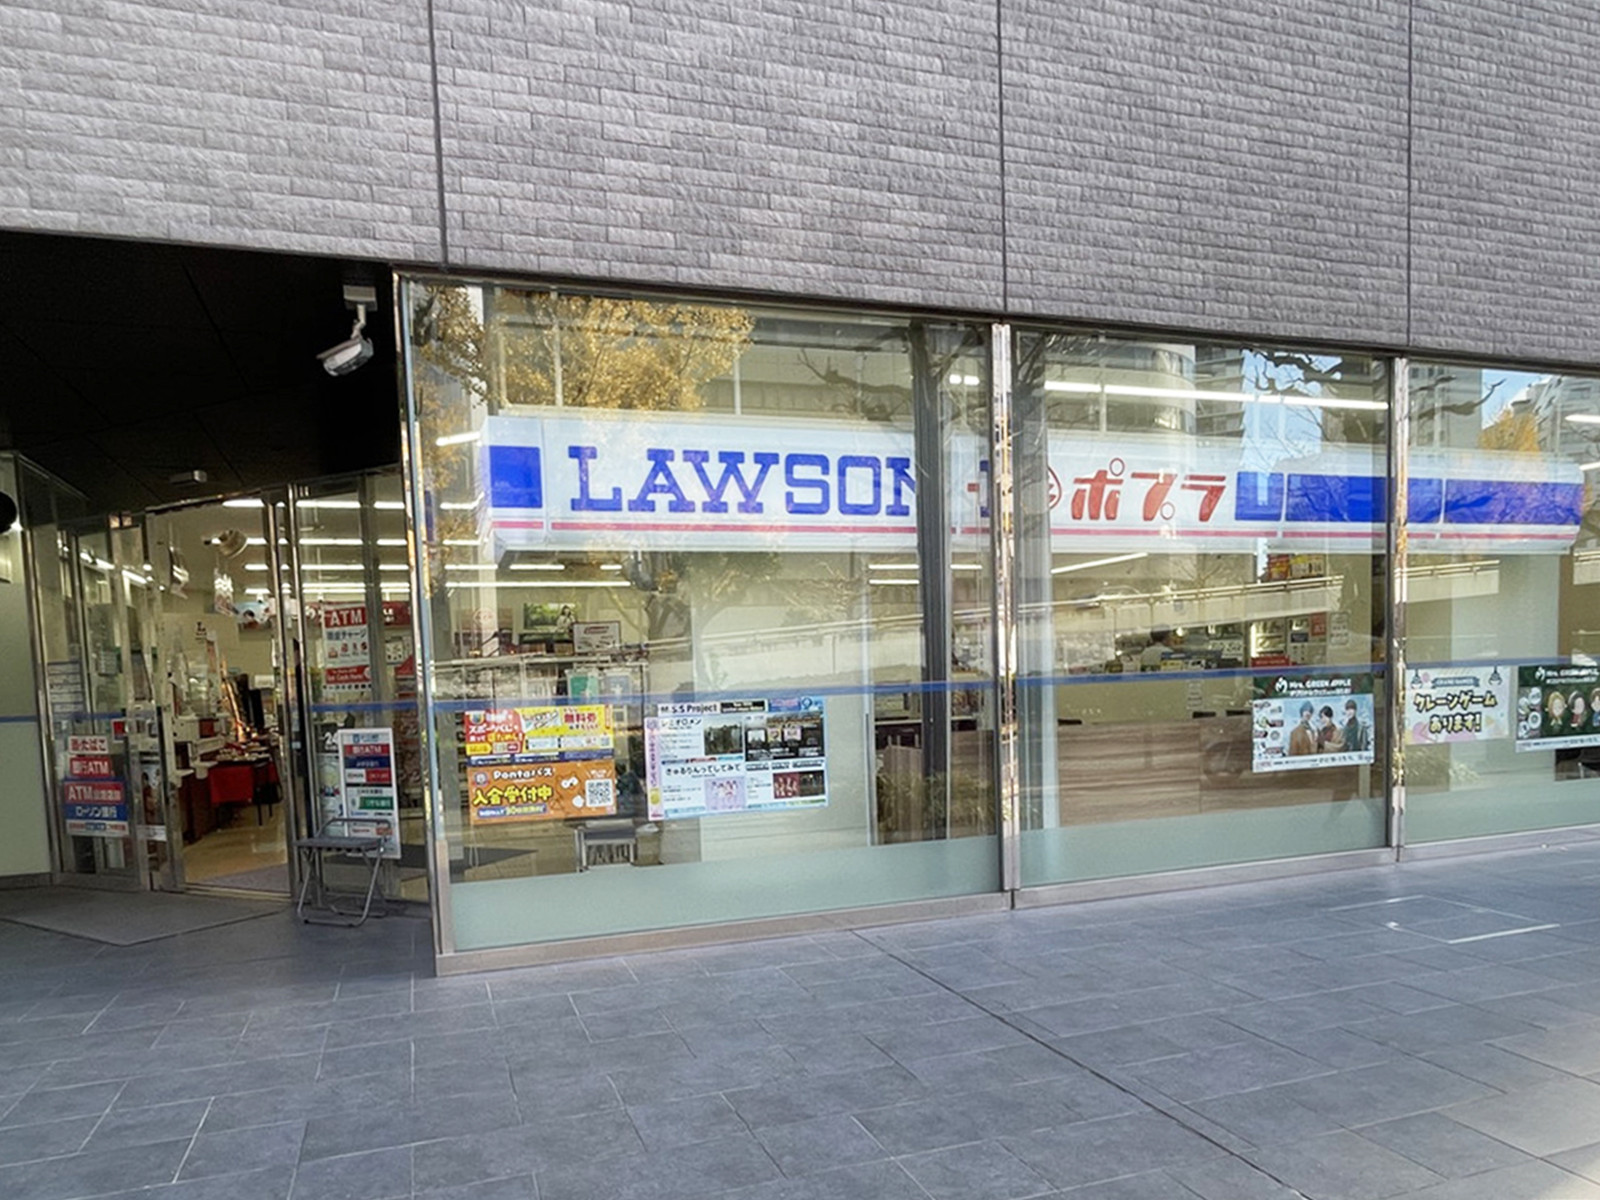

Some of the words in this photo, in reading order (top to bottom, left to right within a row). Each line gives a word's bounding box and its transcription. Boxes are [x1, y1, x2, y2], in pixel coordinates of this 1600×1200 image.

[1071, 457, 1227, 522] ポプラ
[330, 609, 363, 626] ATM
[687, 703, 718, 714] Project
[1413, 690, 1498, 713] クレーンゲーム
[72, 760, 110, 775] 銀行ATM
[666, 763, 741, 776] きゅるりんってしてみて
[69, 785, 93, 801] ATM
[473, 784, 553, 805] 入会受付中
